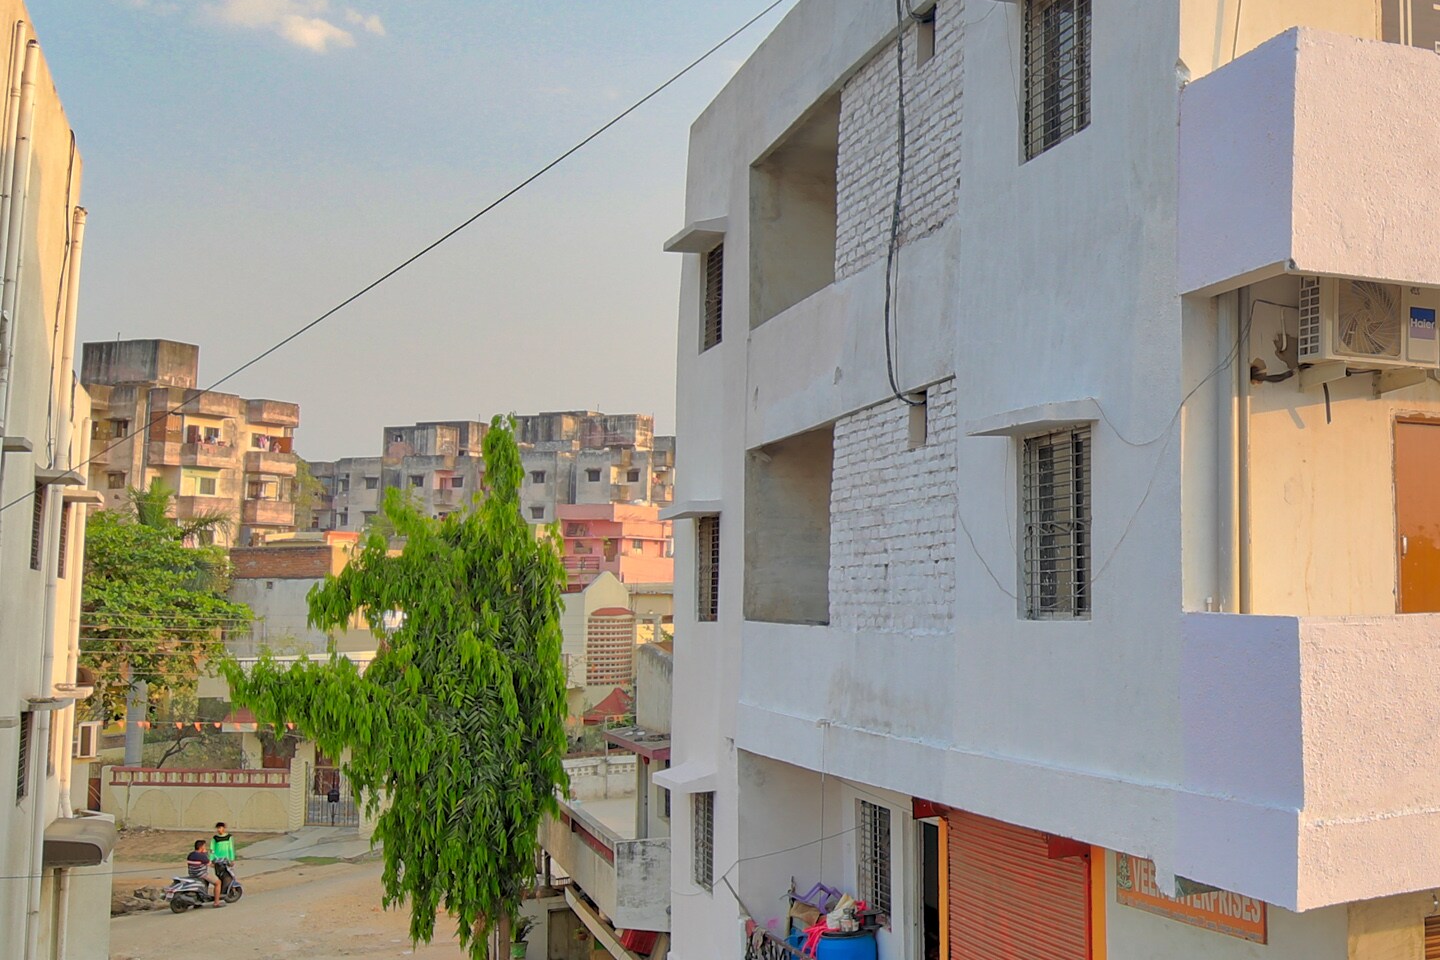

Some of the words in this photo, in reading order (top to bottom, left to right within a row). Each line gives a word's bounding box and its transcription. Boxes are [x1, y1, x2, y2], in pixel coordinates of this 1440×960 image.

[1410, 318, 1435, 329] Haier
[1131, 857, 1165, 899] VEE
[1168, 890, 1261, 924] RPRISES
